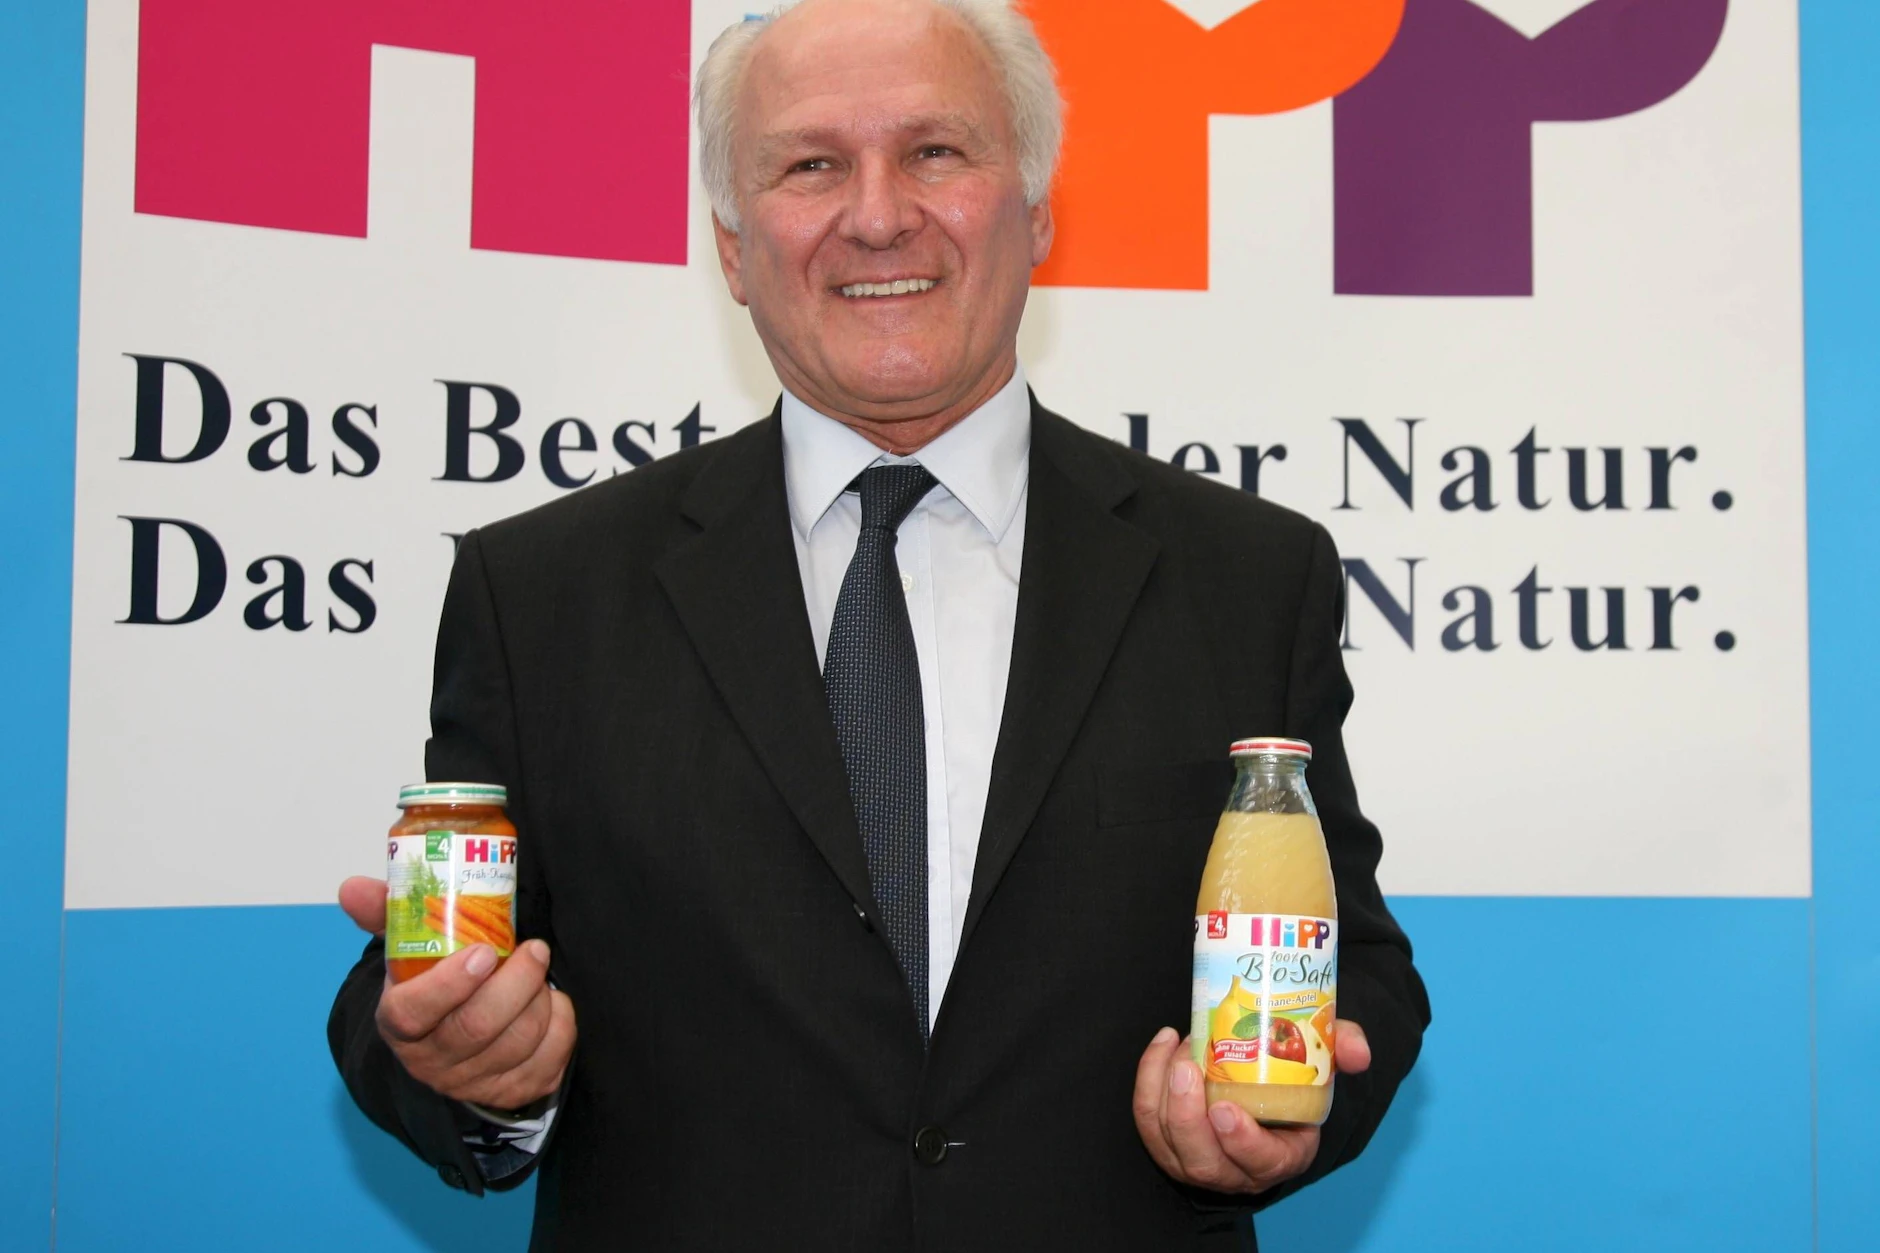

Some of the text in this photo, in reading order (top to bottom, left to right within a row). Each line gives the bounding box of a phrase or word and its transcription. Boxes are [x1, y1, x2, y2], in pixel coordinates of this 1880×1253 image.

[134, 0, 1728, 297] HPP
[118, 352, 381, 478] Das
[1331, 417, 1734, 512] Natur.
[114, 515, 377, 634] Das
[1341, 558, 1736, 653] Natur.
[465, 839, 517, 864] HiPP
[1251, 917, 1330, 949] HiPP
[1256, 993, 1317, 1007] Bnane-Apfel
